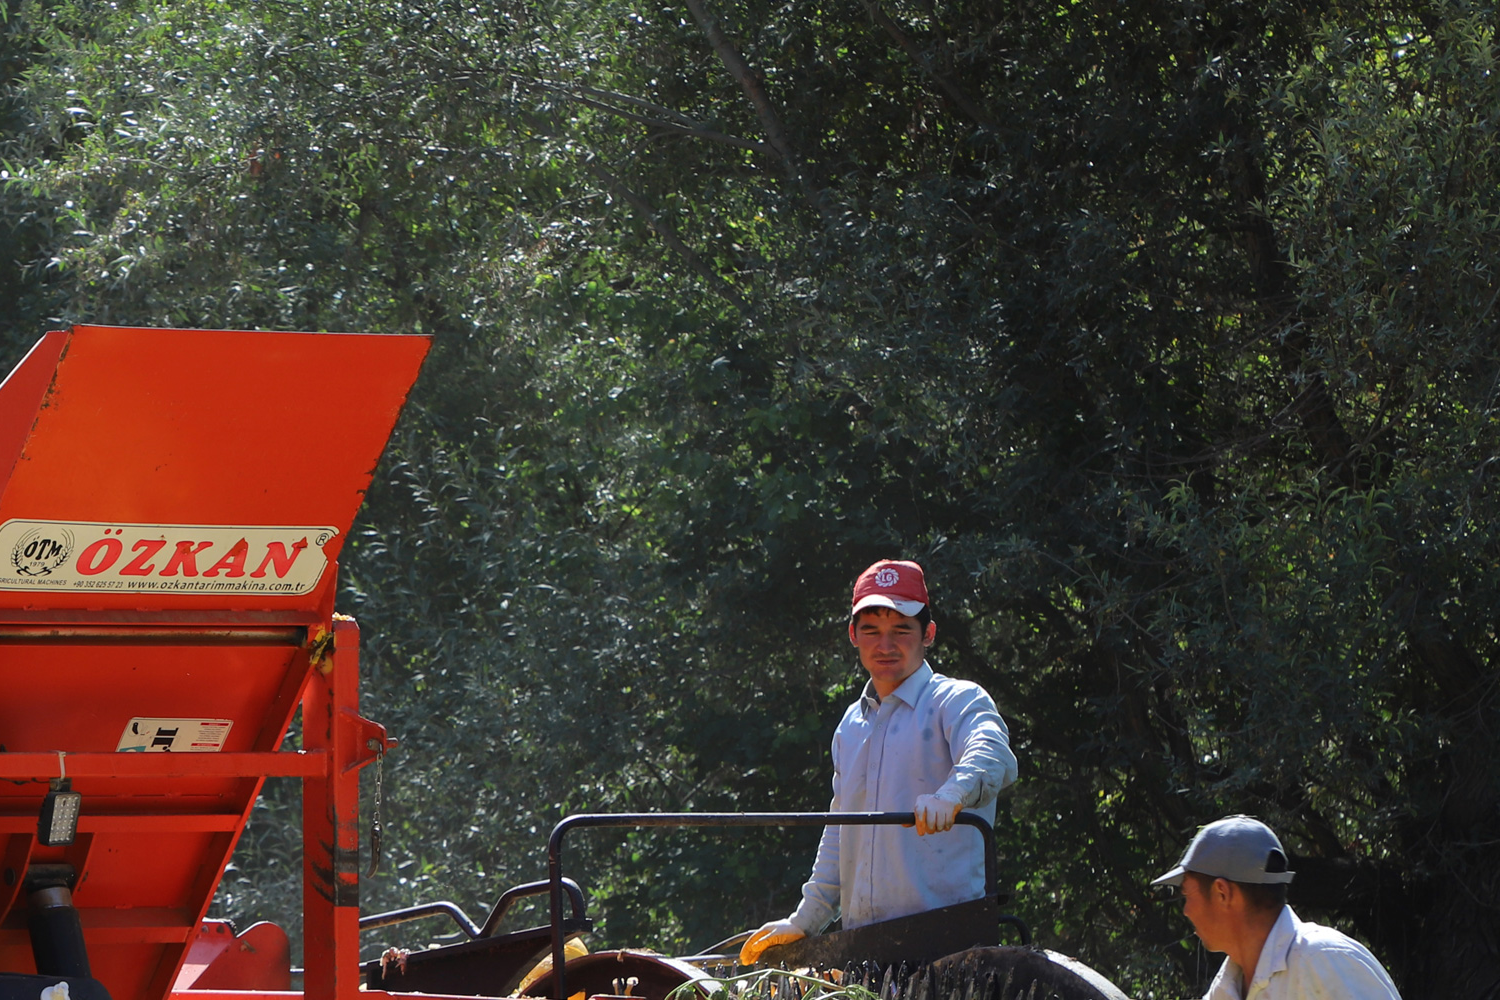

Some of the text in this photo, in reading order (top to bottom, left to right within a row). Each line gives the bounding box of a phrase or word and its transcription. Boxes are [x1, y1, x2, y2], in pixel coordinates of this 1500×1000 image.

[75, 528, 308, 578] ÖZKAN
[882, 573, 892, 582] LG
[127, 579, 306, 591] www.ozkantarimmakina.com.tr
